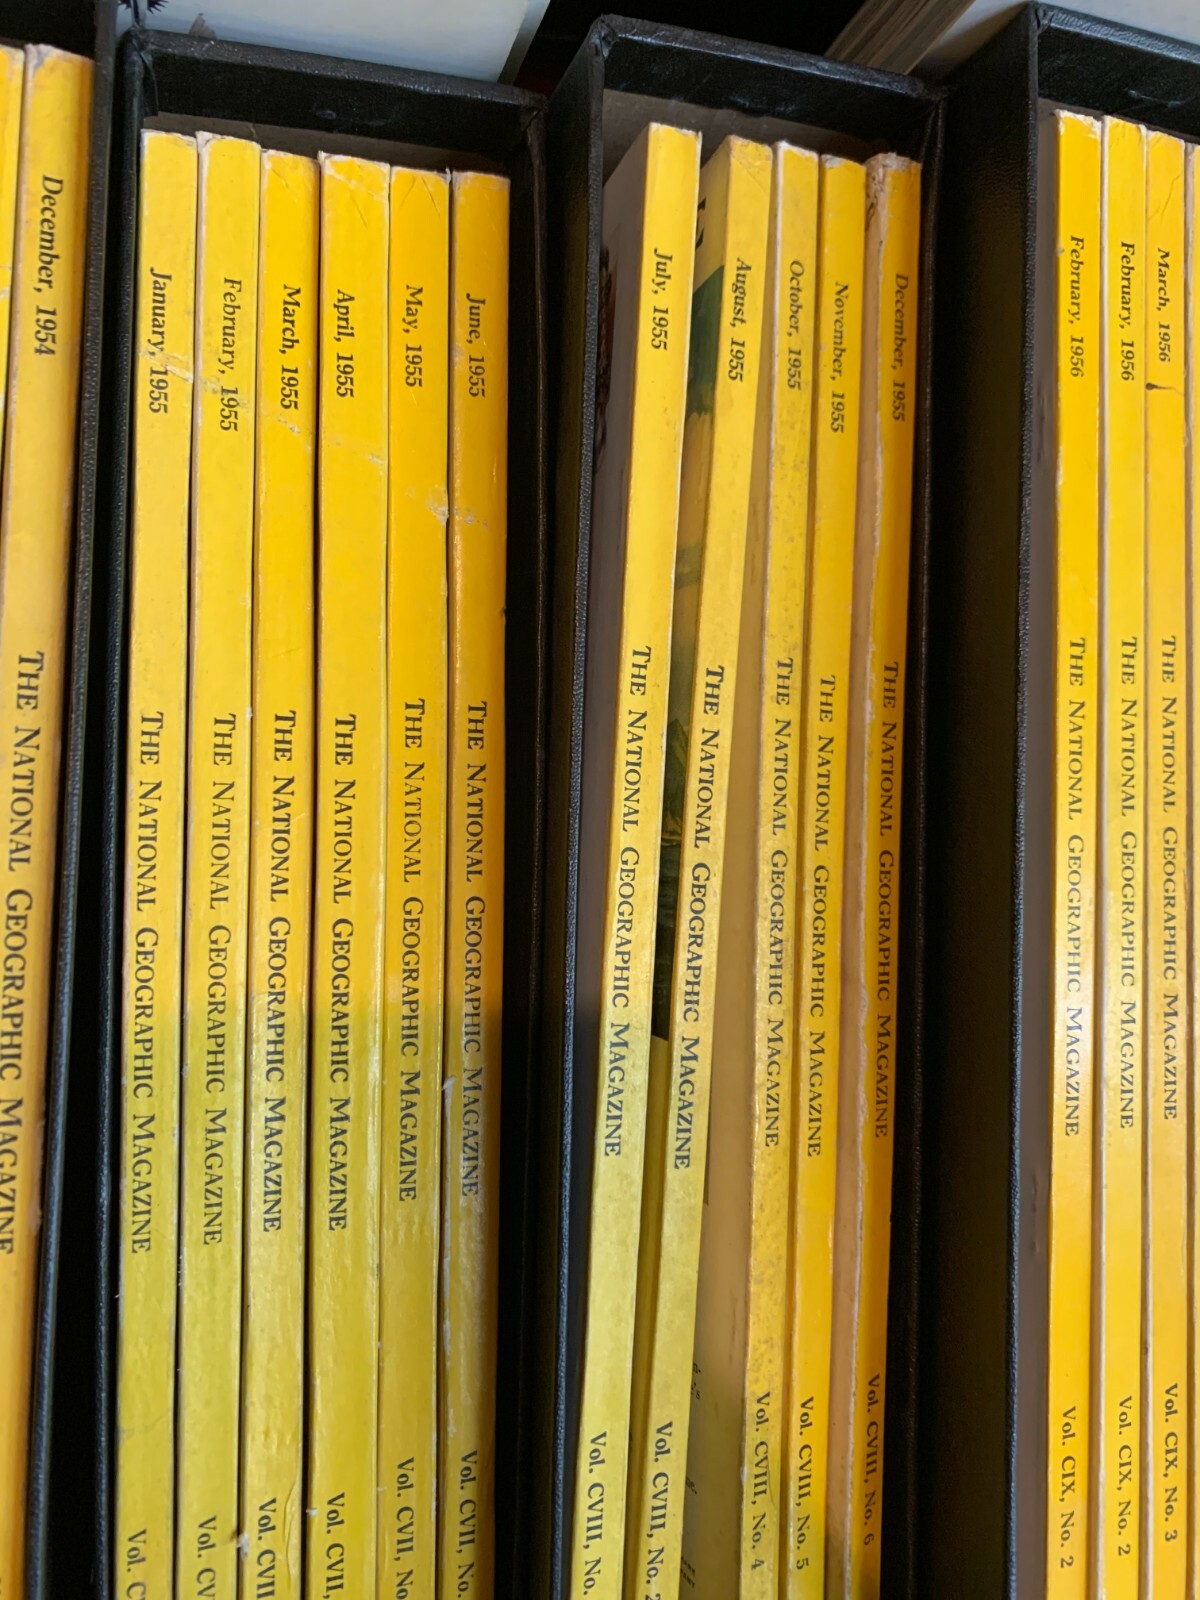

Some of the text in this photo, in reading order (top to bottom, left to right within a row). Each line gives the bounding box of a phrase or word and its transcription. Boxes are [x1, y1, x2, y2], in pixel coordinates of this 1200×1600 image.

[34, 174, 64, 356] December, 1954
[147, 267, 173, 414] January, 1955
[403, 284, 424, 388] May, 1955
[650, 247, 674, 351] July, 1955
[727, 257, 752, 382] August, 1955
[786, 260, 804, 391] October, 1955
[1068, 235, 1085, 378] February, 1956
[1119, 241, 1135, 382] February, 1956
[1156, 247, 1171, 363] March, 1956
[219, 277, 243, 432] February, 1955
[279, 284, 302, 410] March, 1955
[333, 288, 355, 398] April, 1955
[465, 293, 486, 398] June, 1955
[830, 281, 849, 434] November, 1955
[891, 273, 909, 422] December, 1955
[16, 650, 45, 710] THE
[8, 726, 41, 872] NATIONAL
[399, 698, 426, 1202] THE NATIONAL GEOGRAPHIC MAGAZINE
[461, 700, 488, 1197] THE NATIONAL GEOGRAPHIC MAGAZINE
[604, 645, 652, 1157] THE NATIONAL GEOGRAPHIC MAGAZINE
[673, 665, 725, 1170] THE NATIONAL GEOGRAPHIC MAGAZINE
[764, 657, 794, 1148] THE NATIONAL GEOGRAPHIC MAGAZINE
[808, 675, 836, 1157] THE NATIONAL GEOGRAPHIC MAGAZINE
[875, 661, 899, 1138] THE NATIONAL GEOGRAPHIC MAGAZINE
[1065, 637, 1086, 1136] THE NATIONAL GEOGRAPHIC MAGAZINE
[1120, 636, 1137, 1129] THE NATIONAL GEOGRAPHIC MAGAZINE
[1161, 635, 1178, 1120] THE NATIONAL GEOGRAPHIC MAGAZINE
[0, 889, 33, 1081] GEOGRAPHIC
[131, 711, 164, 1254] THE NATIONAL GEOGRAPHIC MAGAZINE
[203, 713, 236, 1246] THE NATIONAL GEOGRAPHIC MAGAZINE
[263, 710, 297, 1233] THE NATIONAL GEOGRAPHIC MAGAZINE
[328, 713, 357, 1232] THE NATIONAL GEOGRAPHIC MAGAZINE
[257, 1497, 277, 1541] Vol.
[397, 1457, 414, 1498] Vol.
[583, 1431, 608, 1595] Vol. CVIII, No.
[647, 1472, 671, 1538] CVIII,
[653, 1421, 673, 1464] Vol.
[751, 1391, 771, 1570] Vol. CVIII, No. 4
[796, 1396, 814, 1570] Vol. CVIII, No. 5
[863, 1374, 880, 1546] Vol. CVIII, No. 6
[1059, 1406, 1076, 1569] Vol. CIX, No. 2
[1116, 1395, 1132, 1557] Vol. CIX, No. 2
[1162, 1383, 1179, 1542] Vol. CIX, No. 3
[127, 1529, 147, 1573] Vol.
[197, 1515, 217, 1558] Vol.
[322, 1492, 345, 1599] Vol. CVII,
[393, 1506, 414, 1561] CVII,
[456, 1450, 478, 1598] Vol. CVII, No.
[646, 1547, 664, 1584] No.
